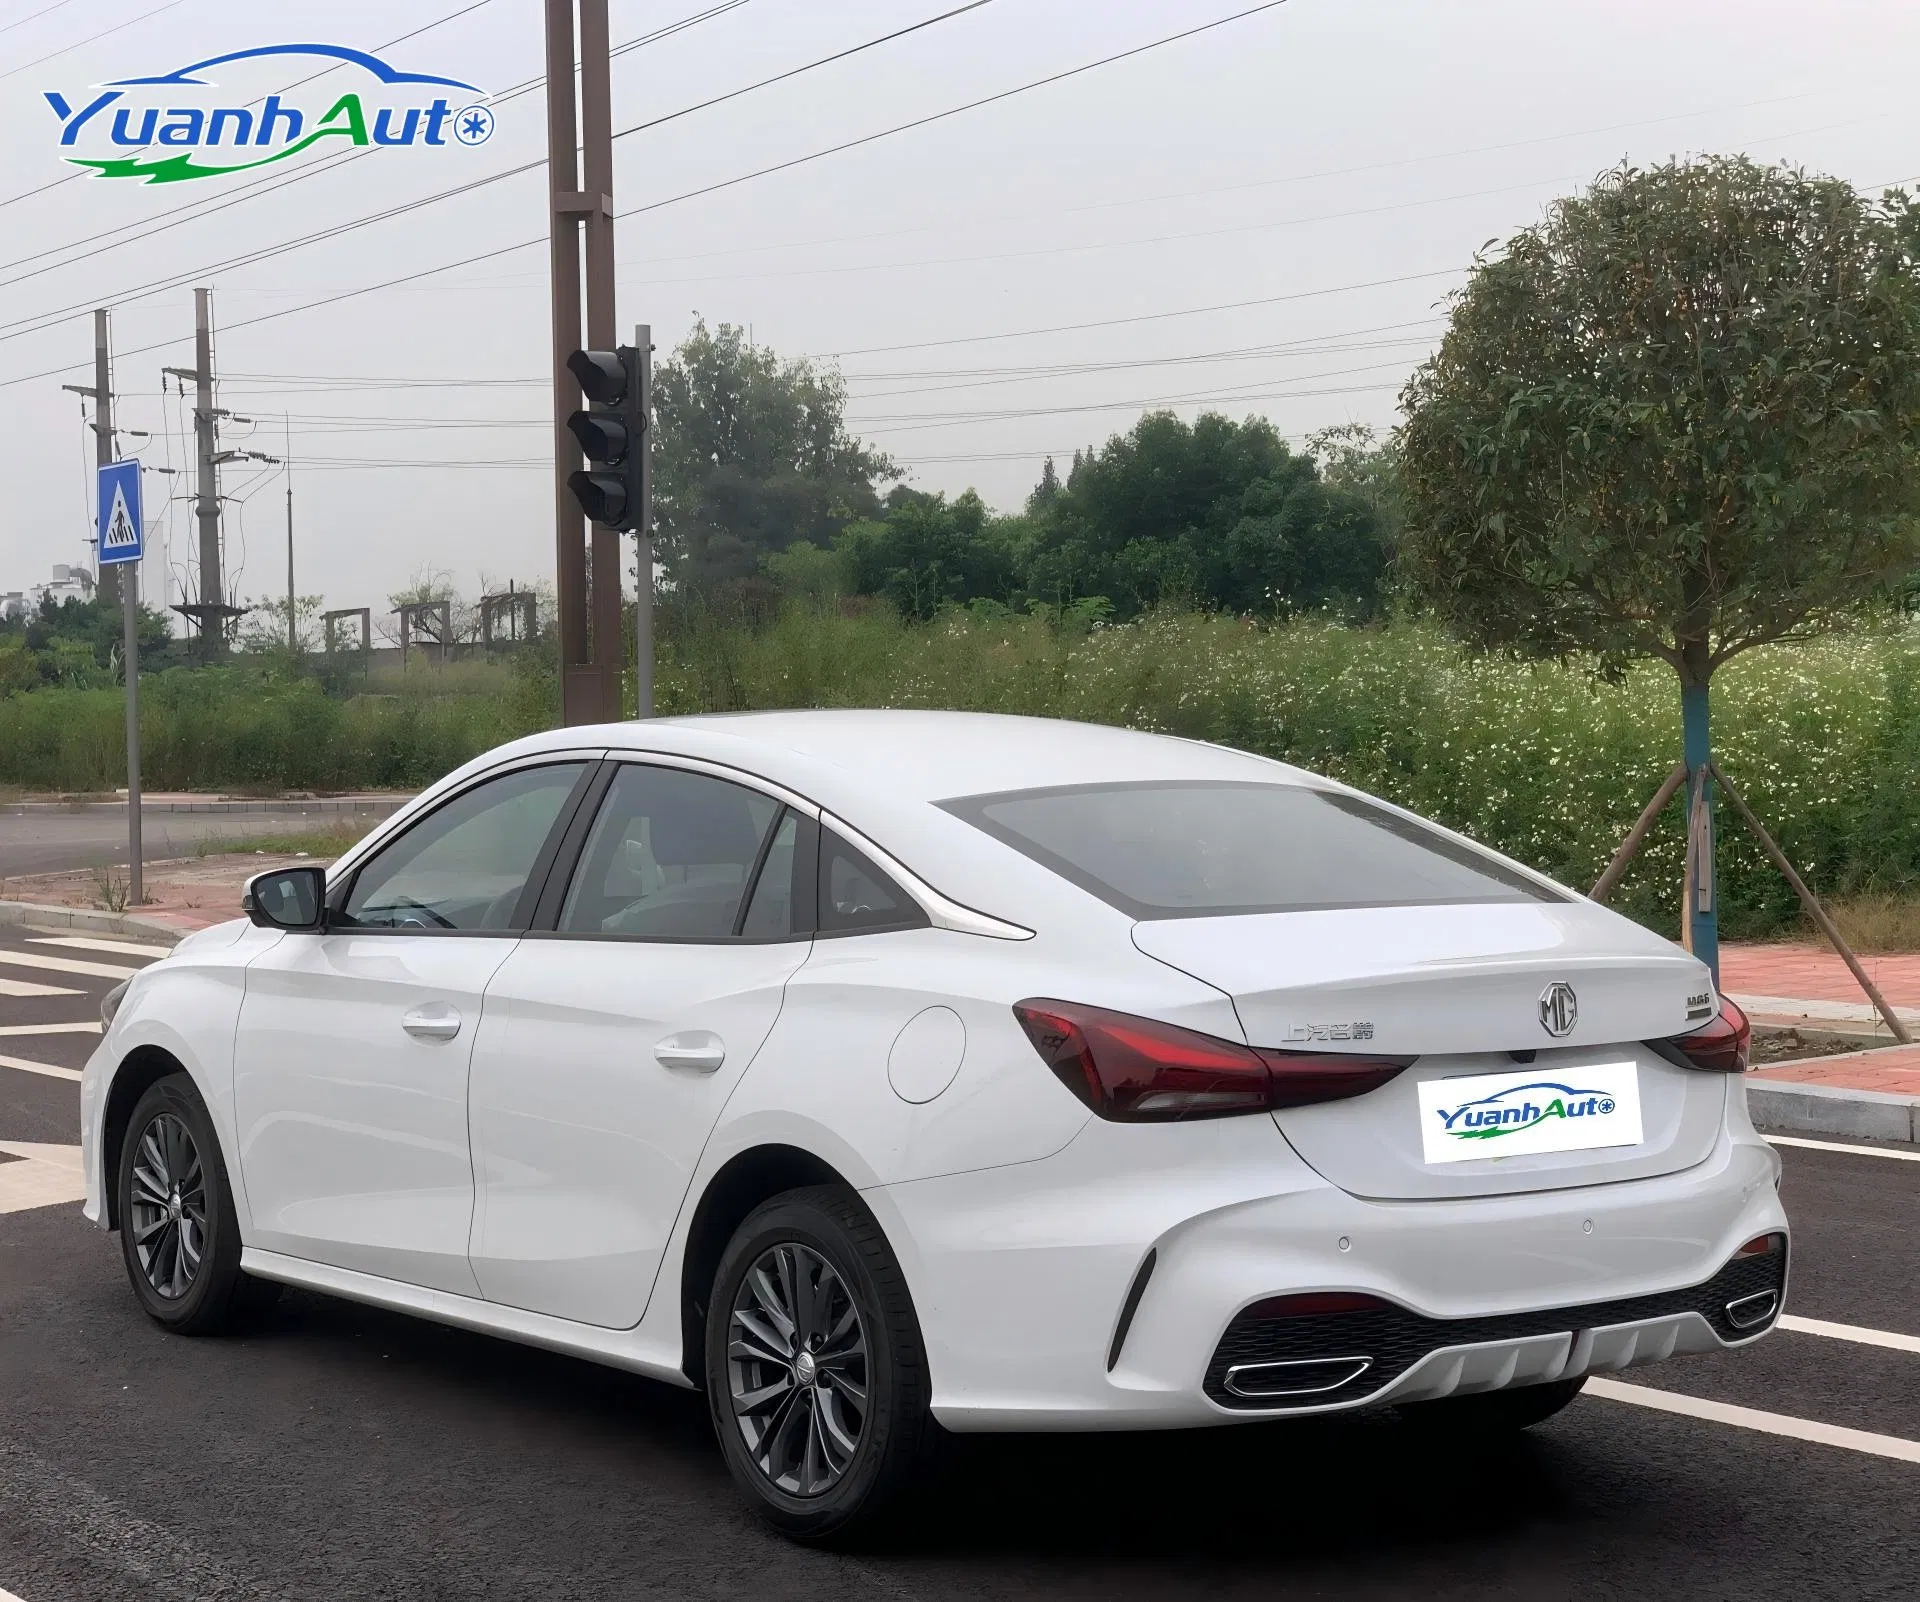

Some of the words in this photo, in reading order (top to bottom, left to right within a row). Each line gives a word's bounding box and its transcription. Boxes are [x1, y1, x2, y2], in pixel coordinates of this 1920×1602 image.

[1540, 985, 1576, 1033] MG
[1687, 993, 1710, 1006] MG6
[1281, 1021, 1374, 1042] 上汽名爵
